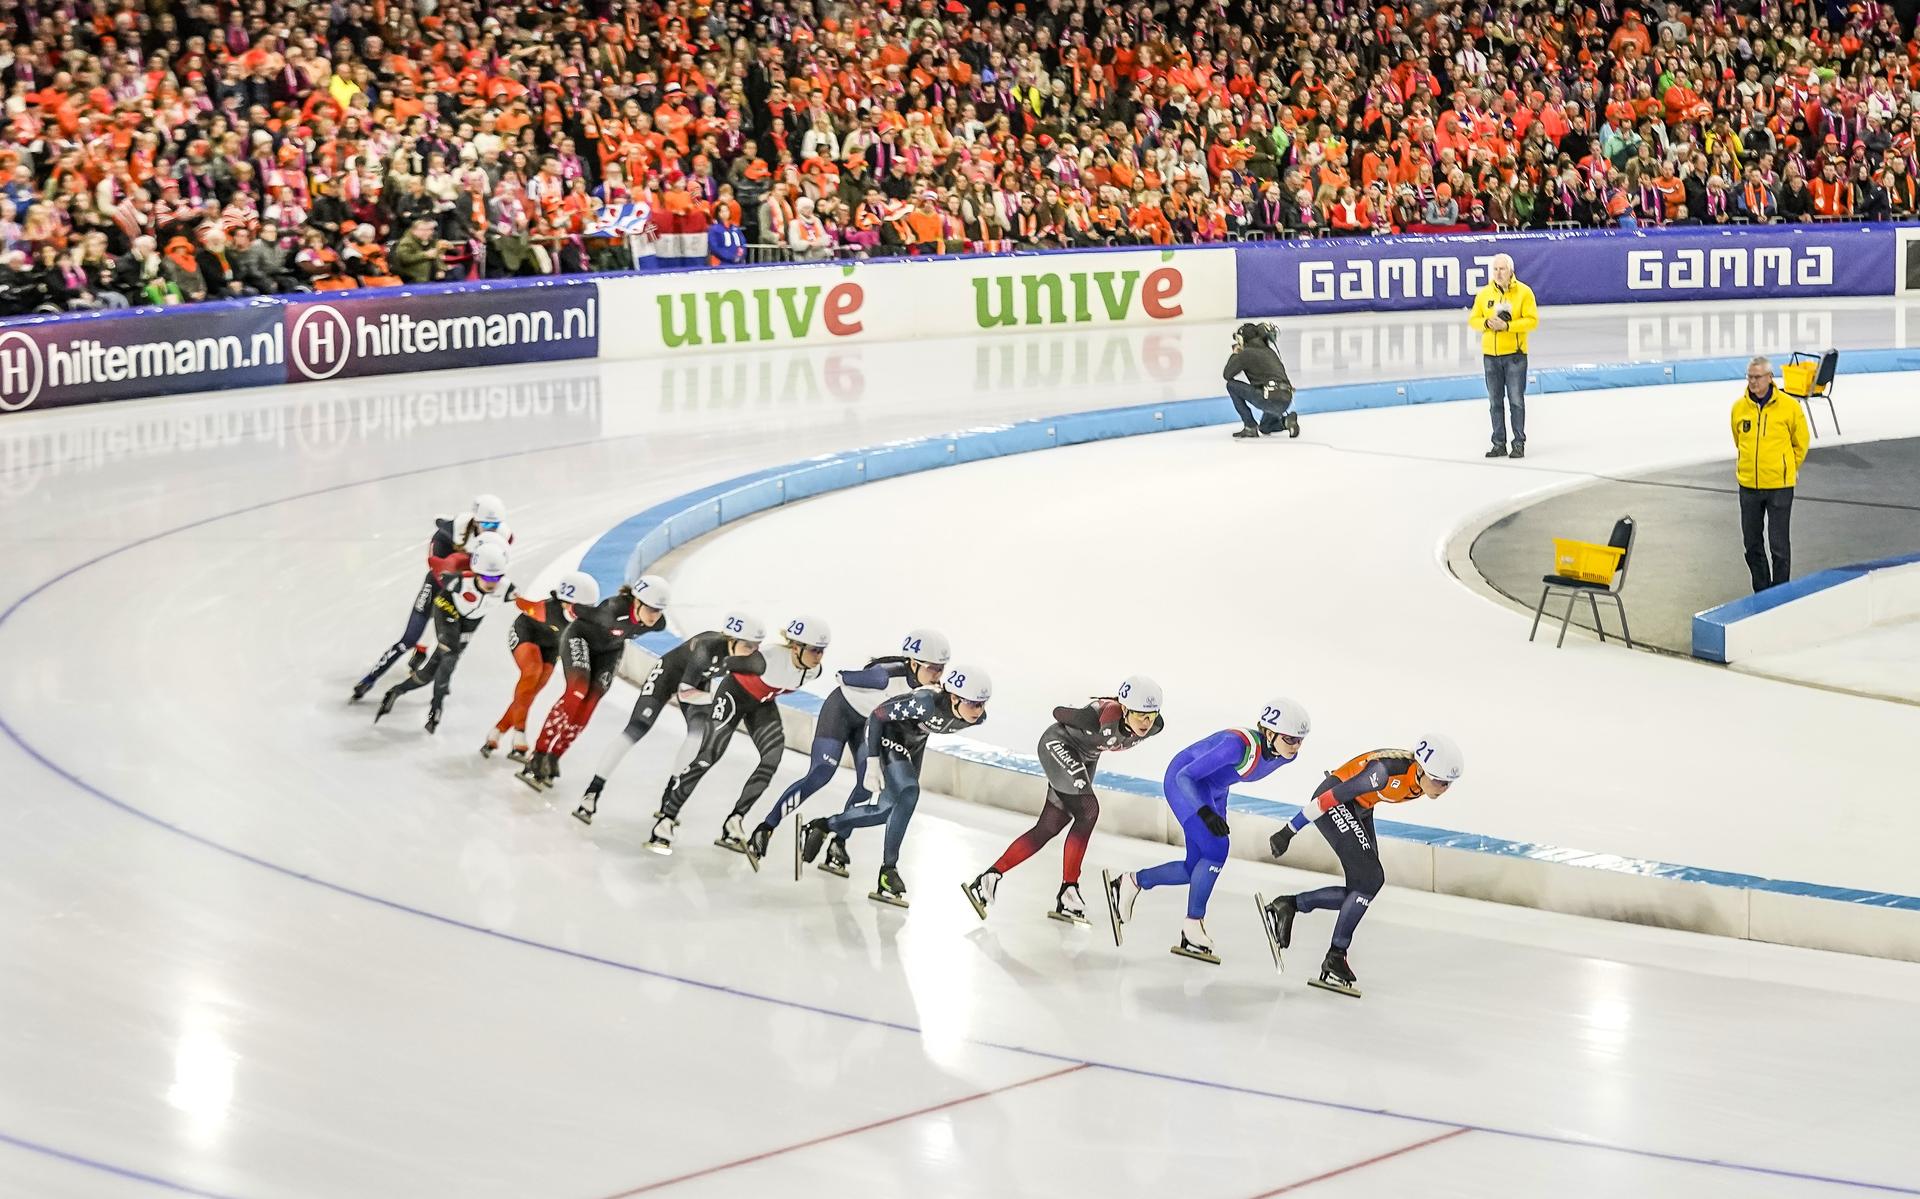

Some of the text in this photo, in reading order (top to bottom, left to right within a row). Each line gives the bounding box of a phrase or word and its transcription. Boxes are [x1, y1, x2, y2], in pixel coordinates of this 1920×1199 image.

[1628, 246, 1834, 290] GAMMA
[973, 249, 1184, 328] univé
[656, 265, 864, 348] univé
[355, 297, 596, 358] hiltermann.nl
[47, 321, 284, 388] hiltermann.nl
[726, 616, 744, 633] 25
[787, 620, 805, 636] 29
[902, 636, 922, 654] 24
[947, 670, 966, 688] 28
[1261, 706, 1281, 726] 22
[880, 736, 913, 761] OYOTA
[1415, 740, 1434, 763] 21
[1336, 803, 1371, 851] DERLANDSE
